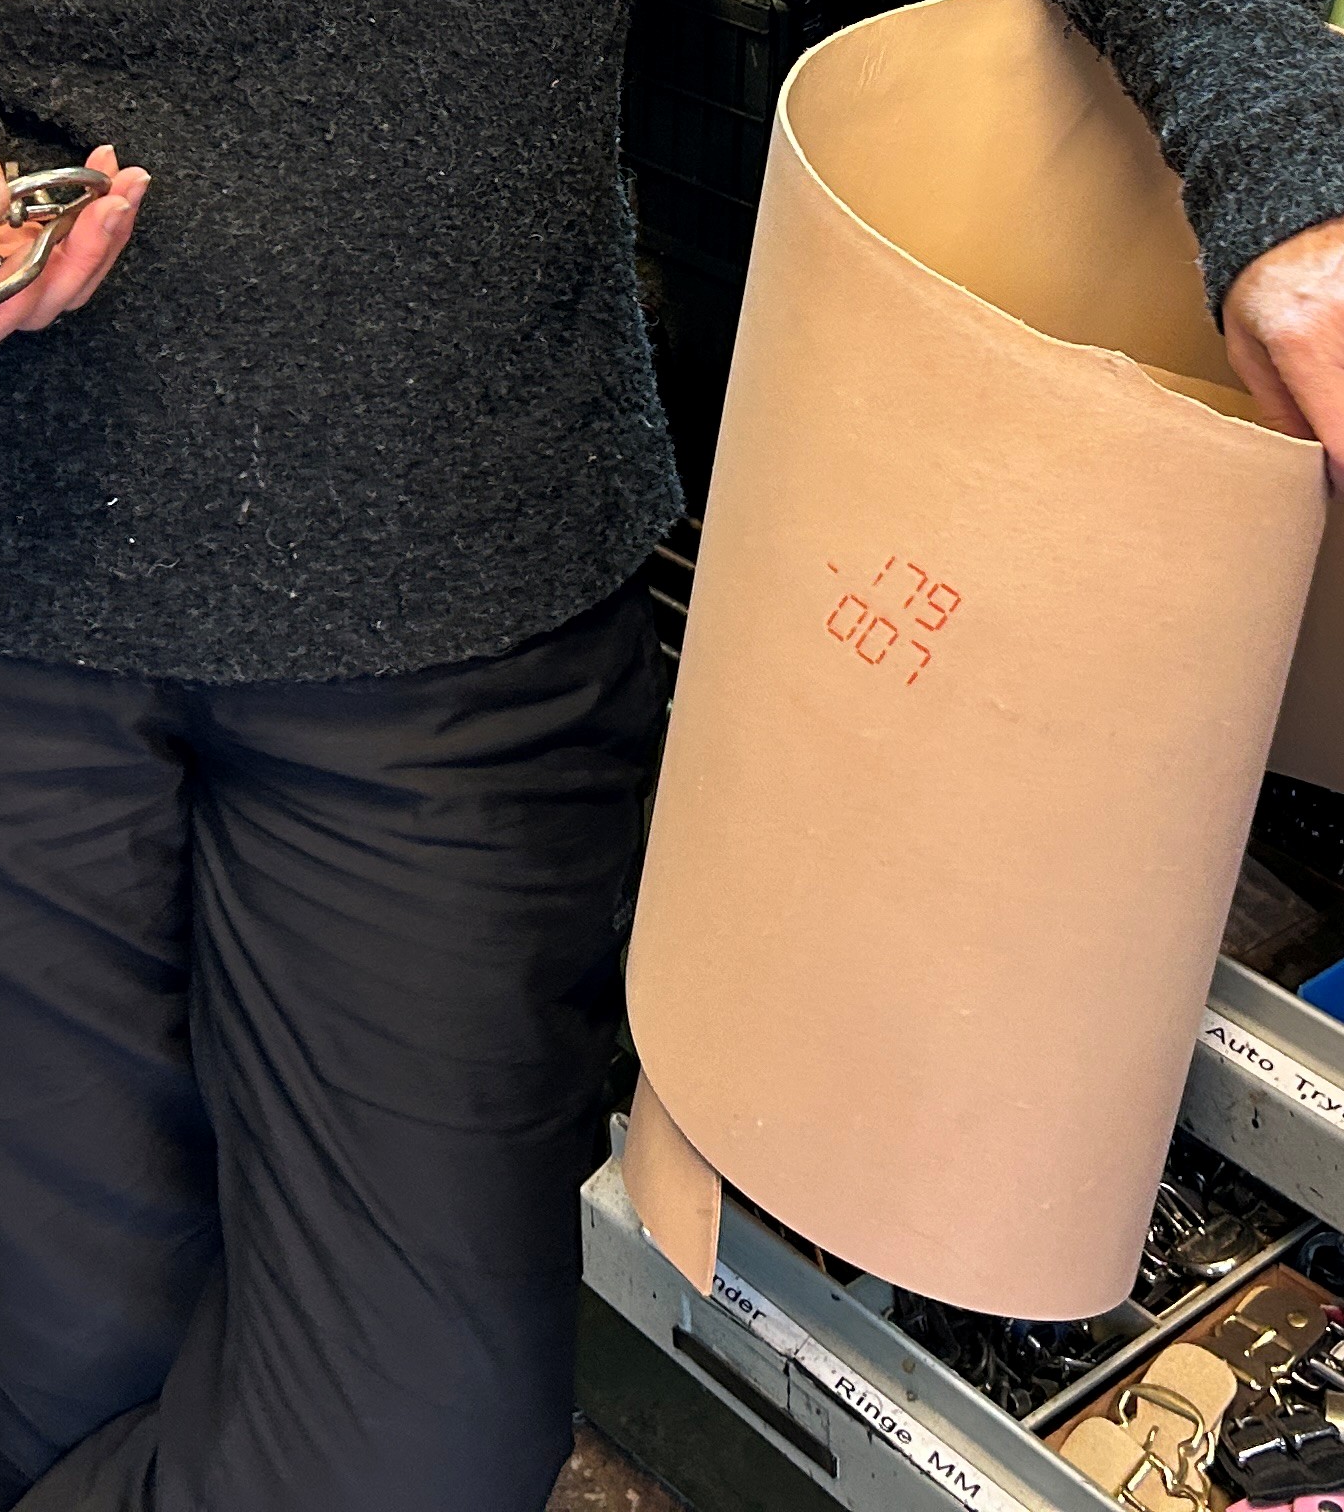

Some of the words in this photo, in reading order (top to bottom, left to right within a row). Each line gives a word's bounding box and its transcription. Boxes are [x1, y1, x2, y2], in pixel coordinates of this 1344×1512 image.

[1205, 1026, 1274, 1072] Auto
[713, 1274, 767, 1321] nder
[835, 1376, 913, 1445] Ringe
[927, 1450, 981, 1499] MM
